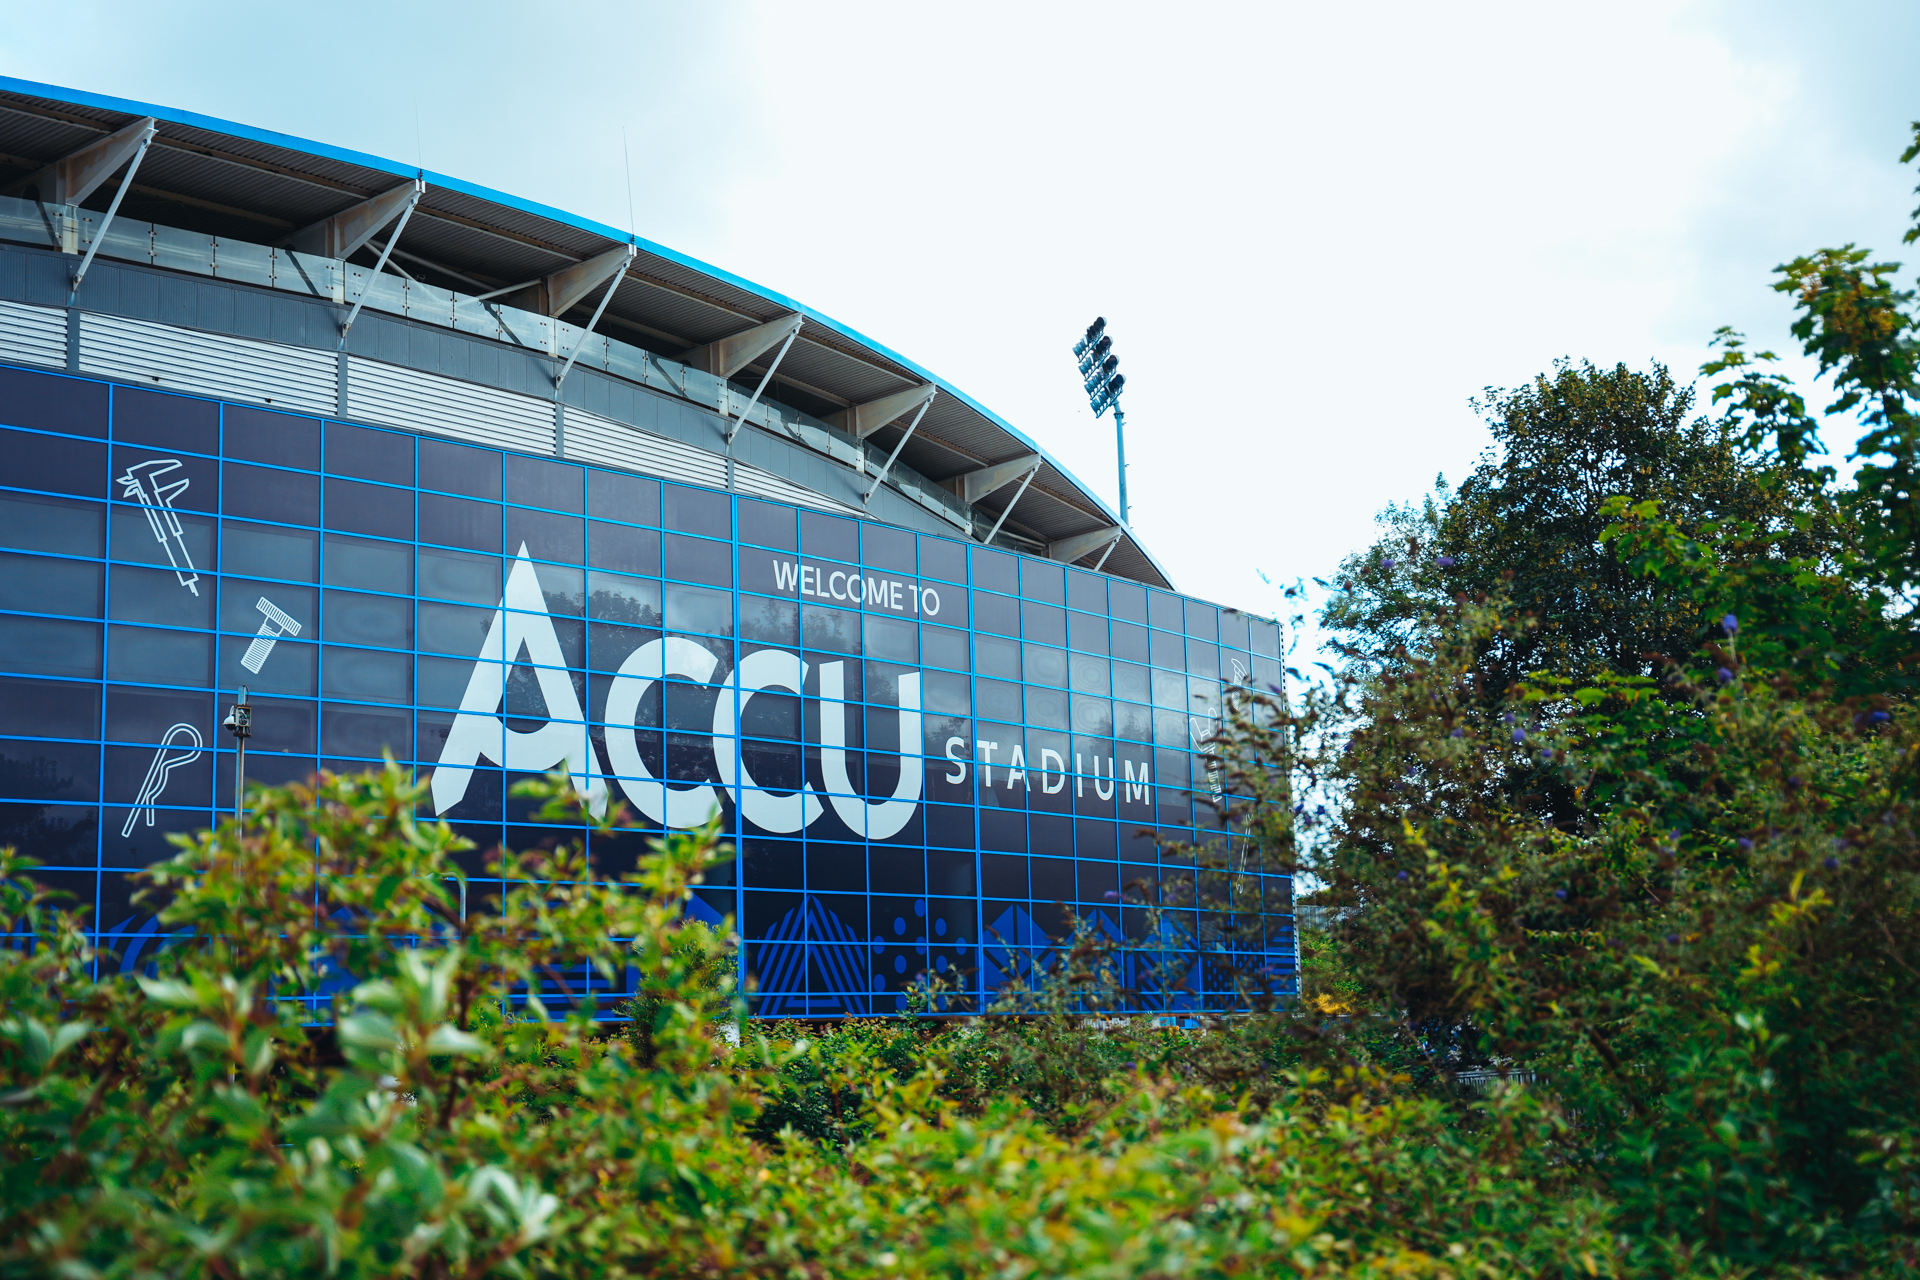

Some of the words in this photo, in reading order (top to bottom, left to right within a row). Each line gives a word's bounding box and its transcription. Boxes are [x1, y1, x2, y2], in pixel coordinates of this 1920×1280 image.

[772, 559, 904, 611] WELCOME
[908, 584, 941, 616] TO
[430, 539, 923, 840] ACCU
[945, 736, 1150, 806] STADIUM
